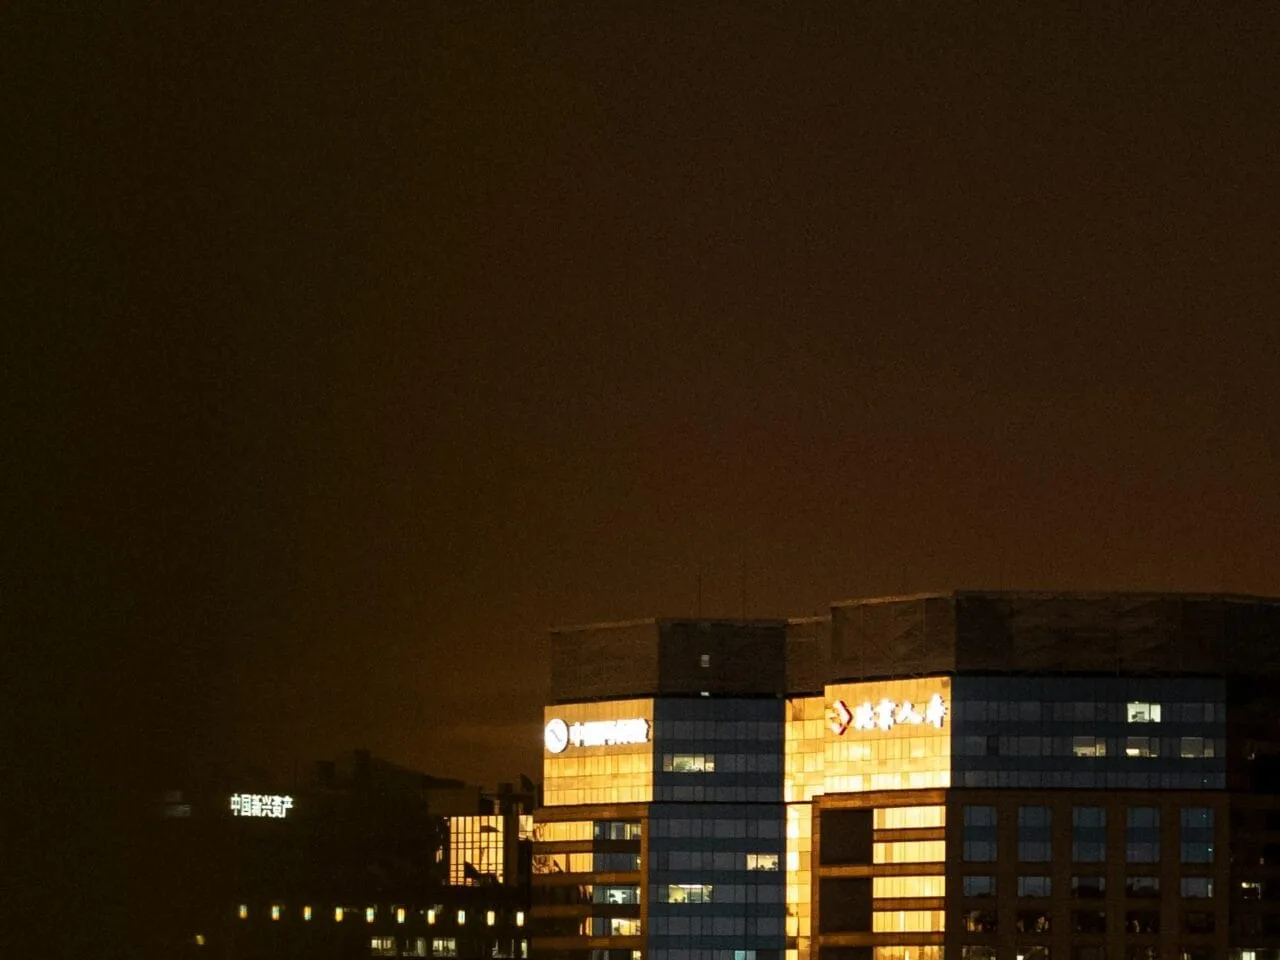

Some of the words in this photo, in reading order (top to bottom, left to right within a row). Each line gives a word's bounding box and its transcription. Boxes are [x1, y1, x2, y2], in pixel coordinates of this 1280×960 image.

[230, 793, 293, 818] 中国新兴资产
